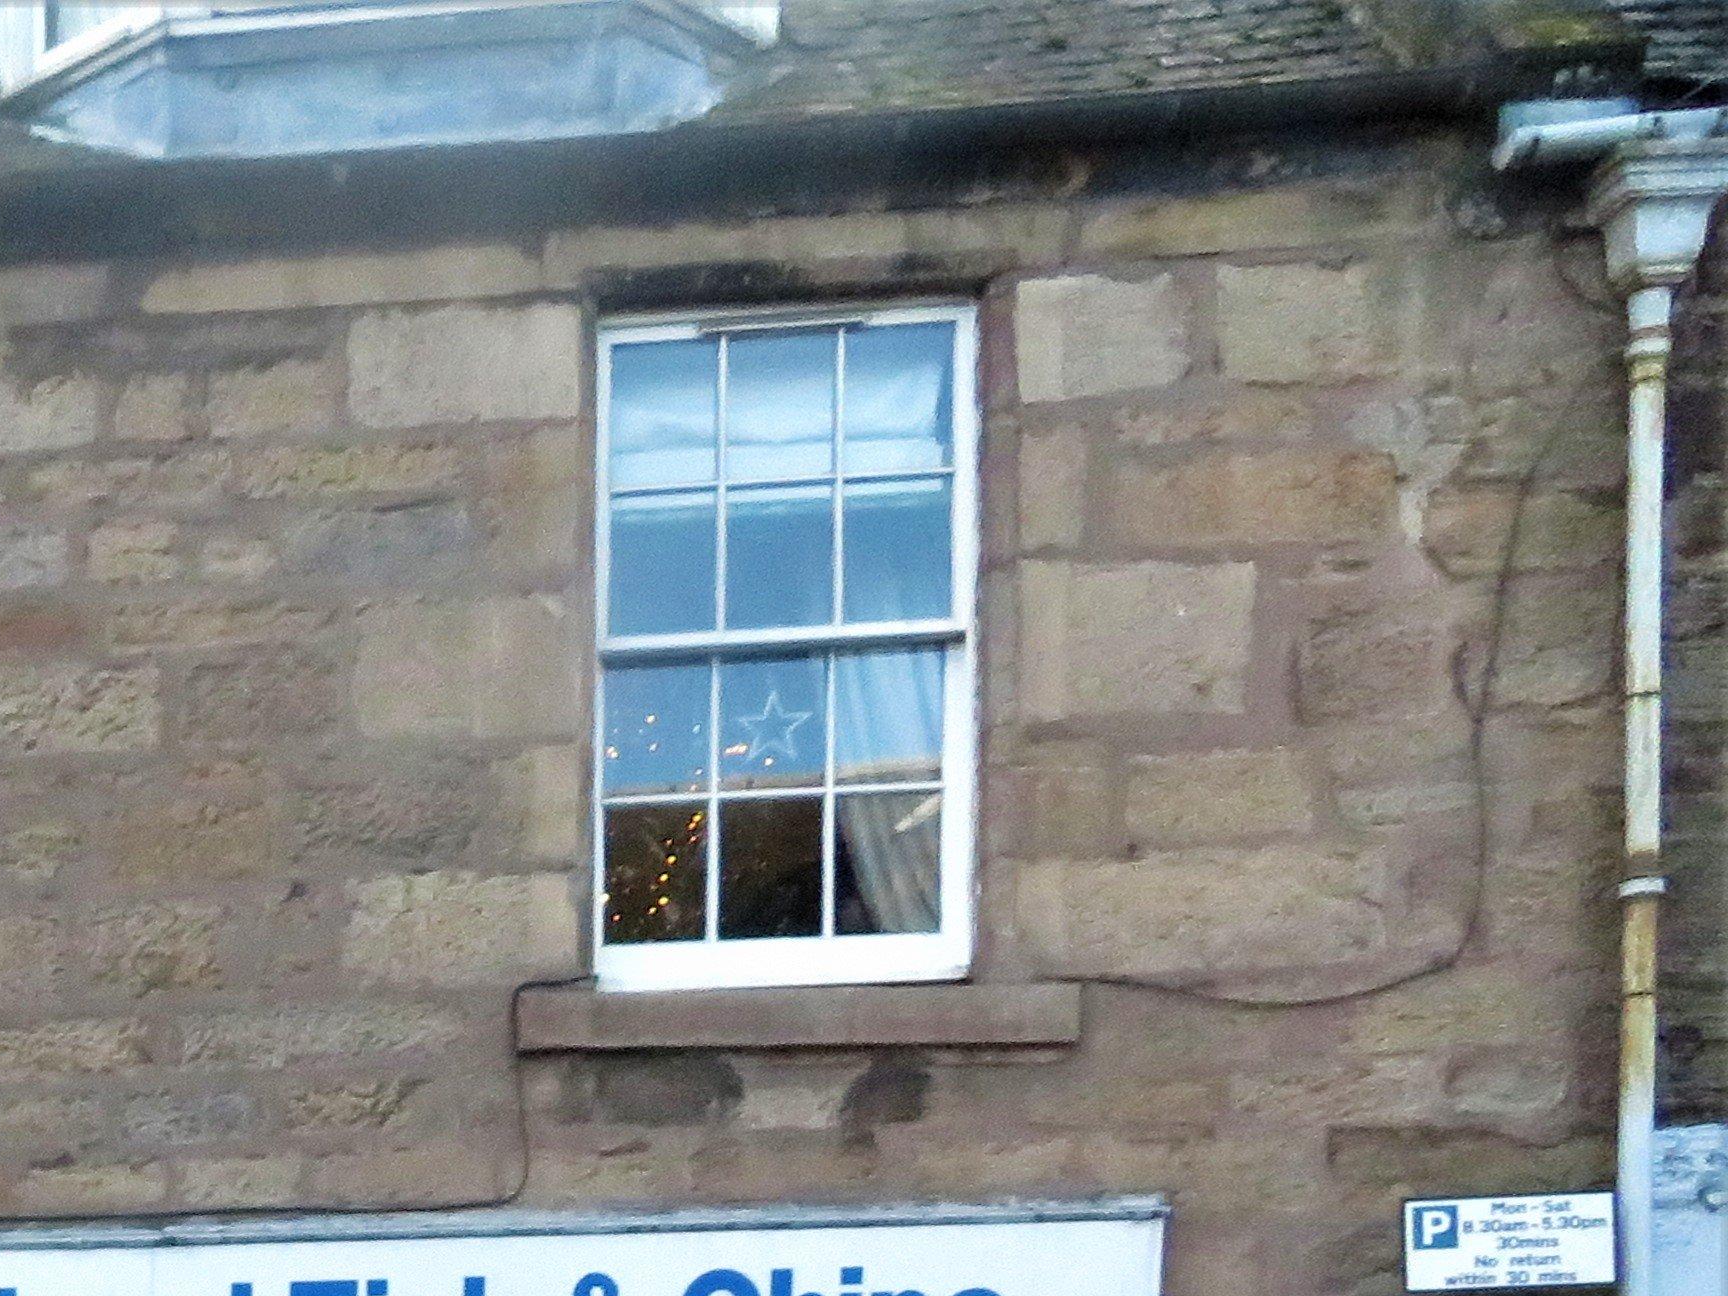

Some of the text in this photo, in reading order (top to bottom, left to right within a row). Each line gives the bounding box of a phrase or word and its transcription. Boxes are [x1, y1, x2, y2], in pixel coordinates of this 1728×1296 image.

[1491, 1201, 1527, 1214] Mon
[1543, 1199, 1572, 1213] Sat
[1421, 1210, 1451, 1246] P
[1474, 1253, 1561, 1268] No return
[1444, 1269, 1578, 1287] within 30 mins
